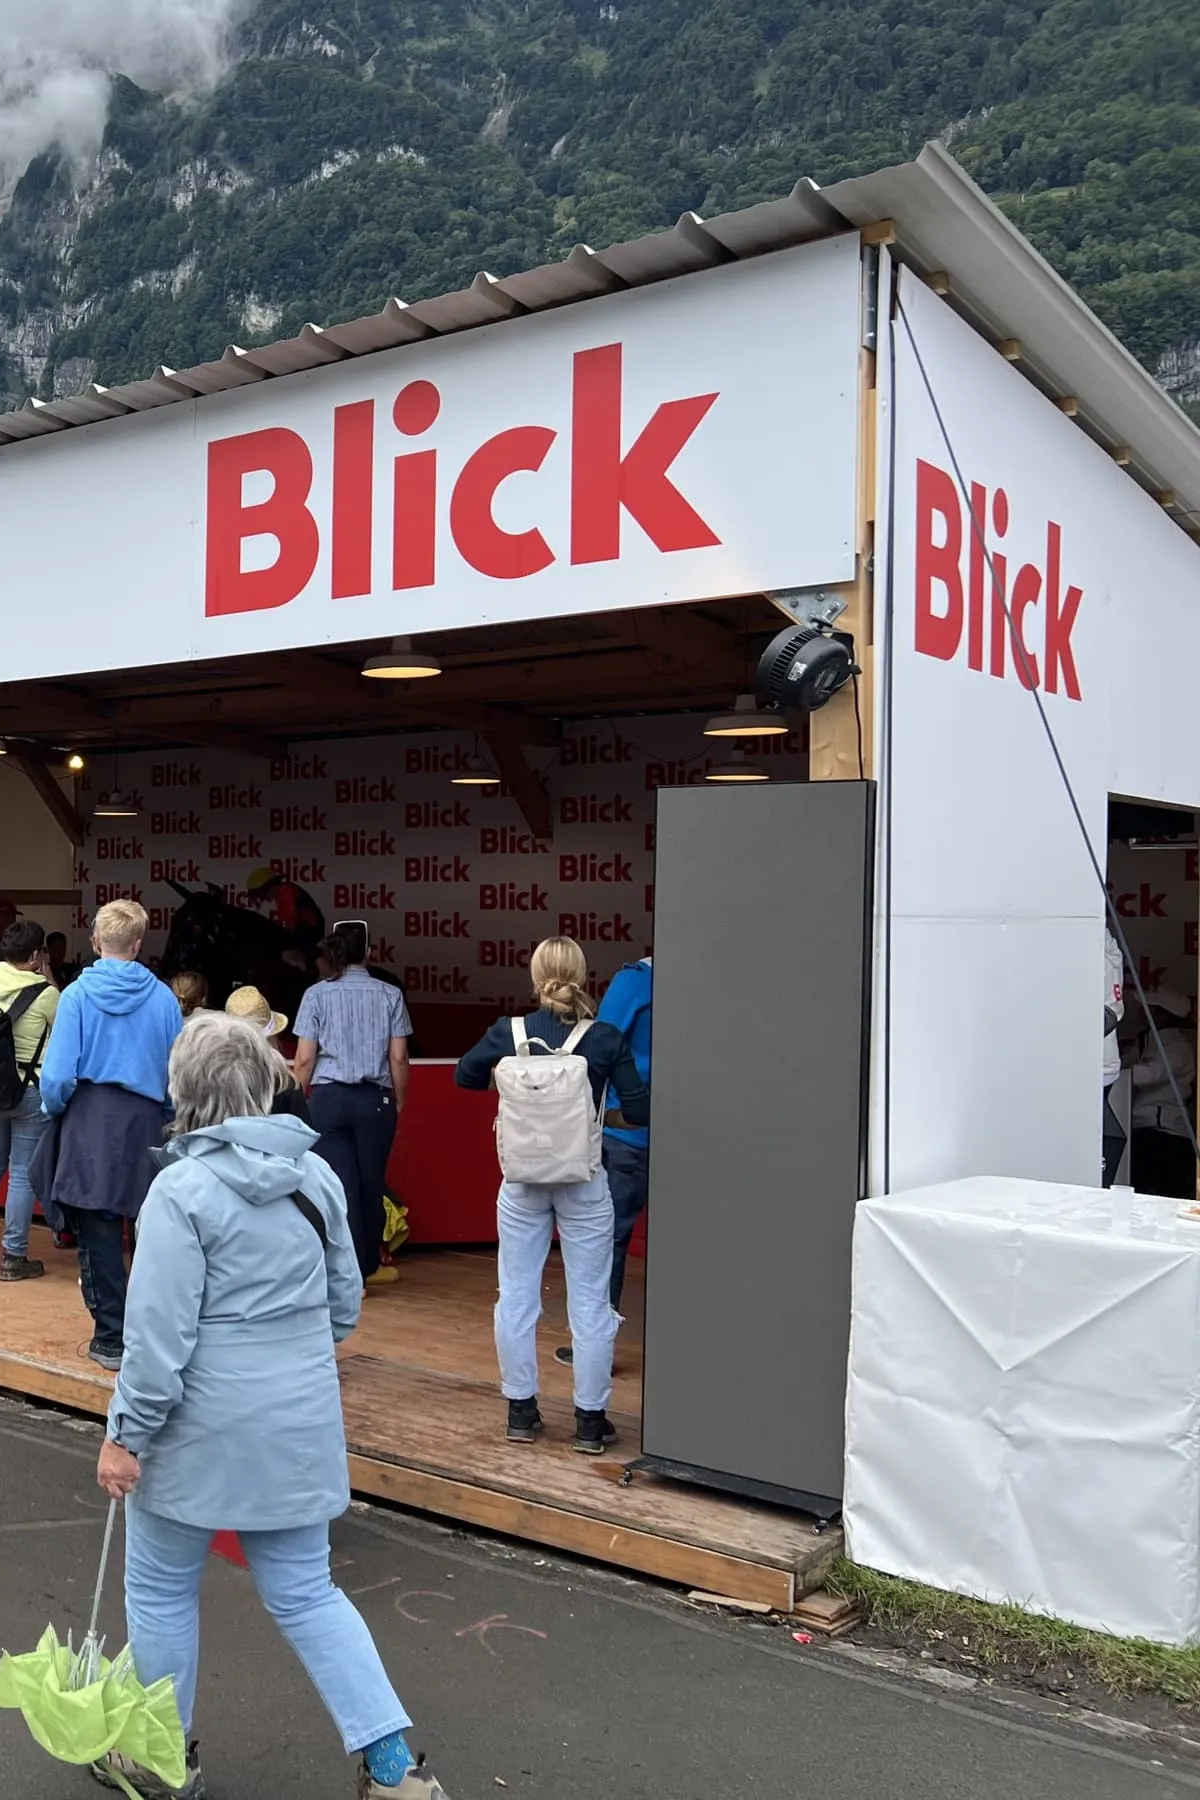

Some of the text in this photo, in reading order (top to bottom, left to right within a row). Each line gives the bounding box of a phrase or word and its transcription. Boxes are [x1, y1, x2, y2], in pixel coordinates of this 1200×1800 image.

[205, 342, 722, 618] Blick
[914, 457, 1084, 702] Blick
[405, 745, 471, 773] Blick
[560, 734, 633, 765] Blick
[152, 762, 201, 788] Blick
[270, 754, 328, 781] Blick
[208, 784, 262, 810] Blick
[335, 775, 396, 804] Blick
[151, 810, 200, 835] Blick
[270, 806, 327, 832] Blick
[405, 801, 471, 828] Blick
[560, 794, 633, 824] Blick
[97, 836, 144, 860] Blick
[208, 834, 262, 859] Blick
[334, 830, 396, 857] Blick
[150, 859, 200, 883] Blick
[404, 856, 471, 882] Blick
[559, 853, 633, 882] Blick
[334, 884, 395, 909] Blick
[479, 882, 549, 912] Blick
[404, 911, 470, 938] Blick
[558, 912, 633, 942] Blick
[478, 939, 534, 968] Blic
[404, 966, 470, 994] Blick
